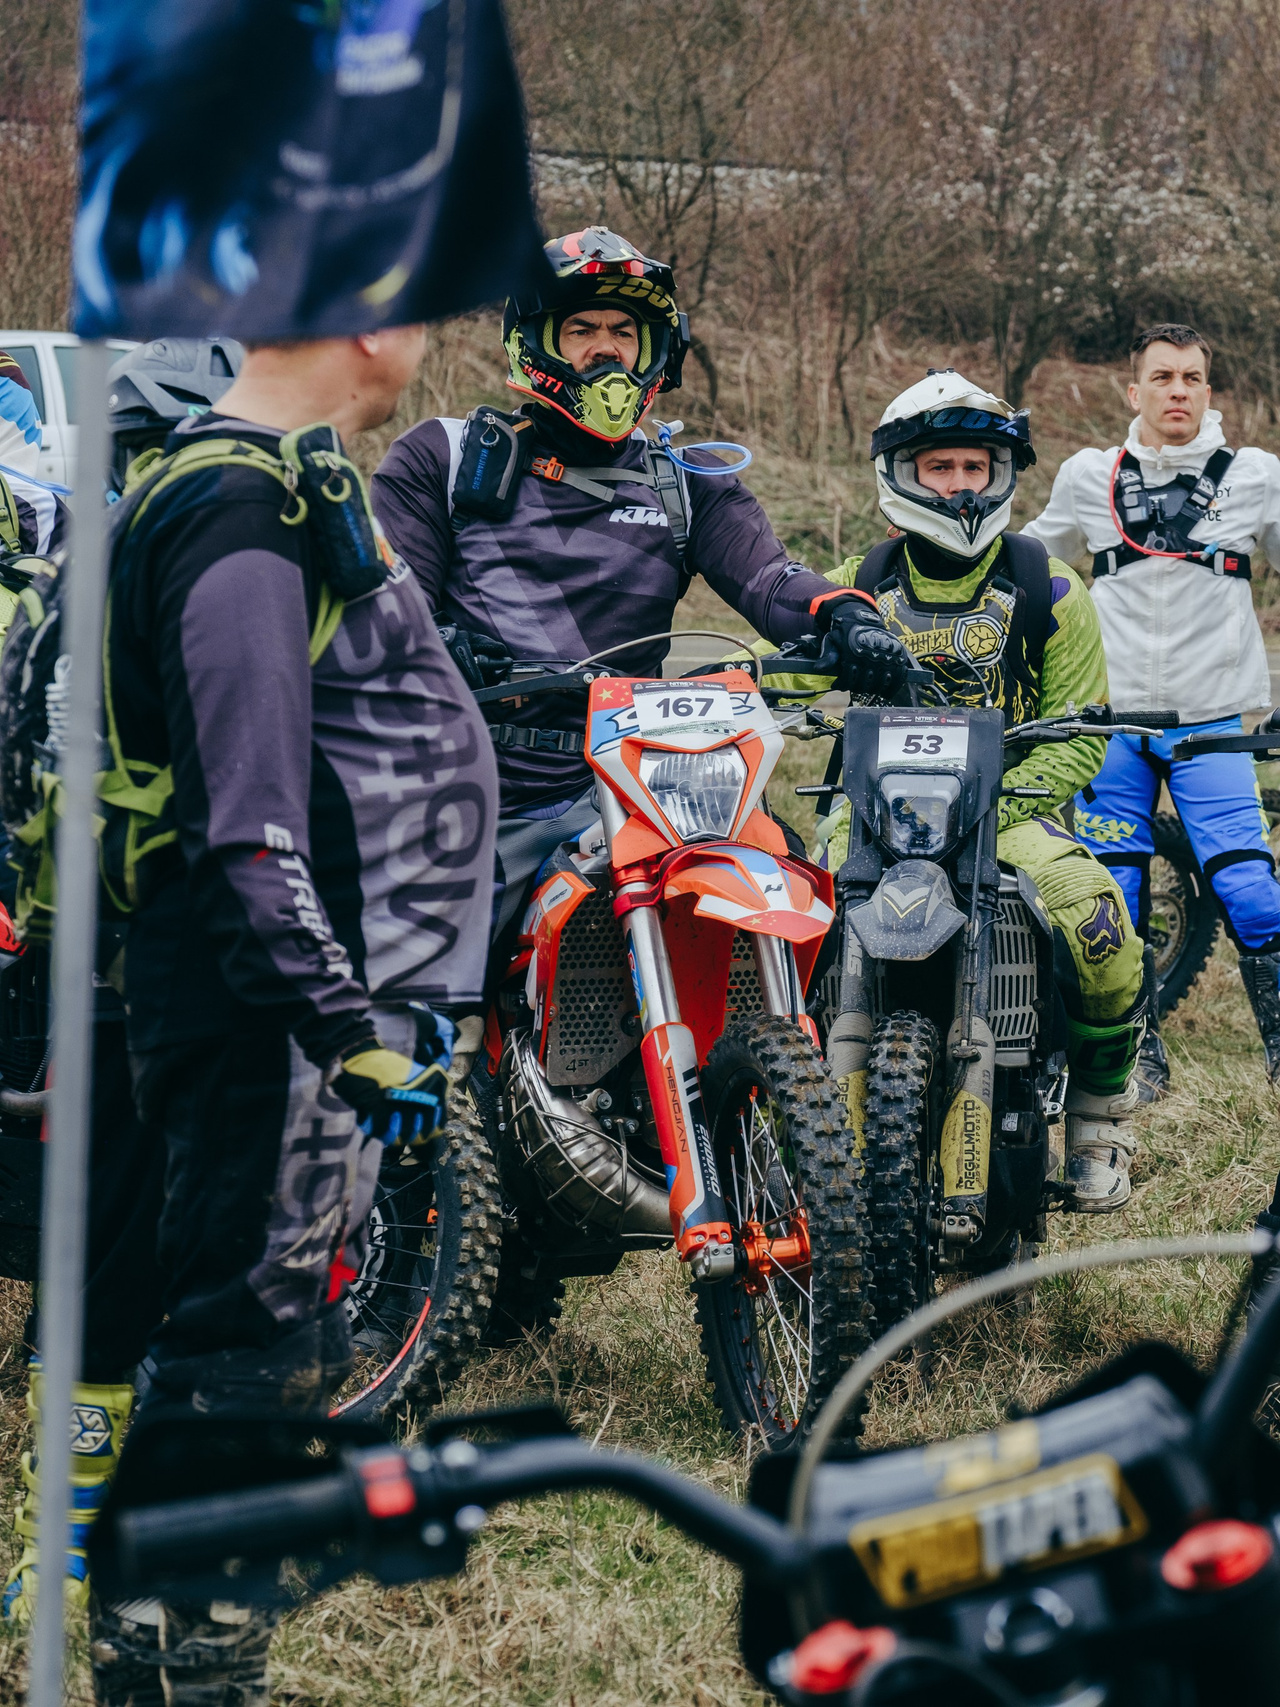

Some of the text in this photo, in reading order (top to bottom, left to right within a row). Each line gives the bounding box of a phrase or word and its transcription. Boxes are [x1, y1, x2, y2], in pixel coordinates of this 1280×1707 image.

[522, 364, 564, 394] JUST1
[609, 506, 669, 527] KTM
[656, 697, 714, 719] 167
[901, 734, 944, 755] 53
[665, 1066, 688, 1153] HENGJIAN
[964, 1099, 976, 1191] REGULMOTO
[699, 1122, 722, 1199] ENDURO
